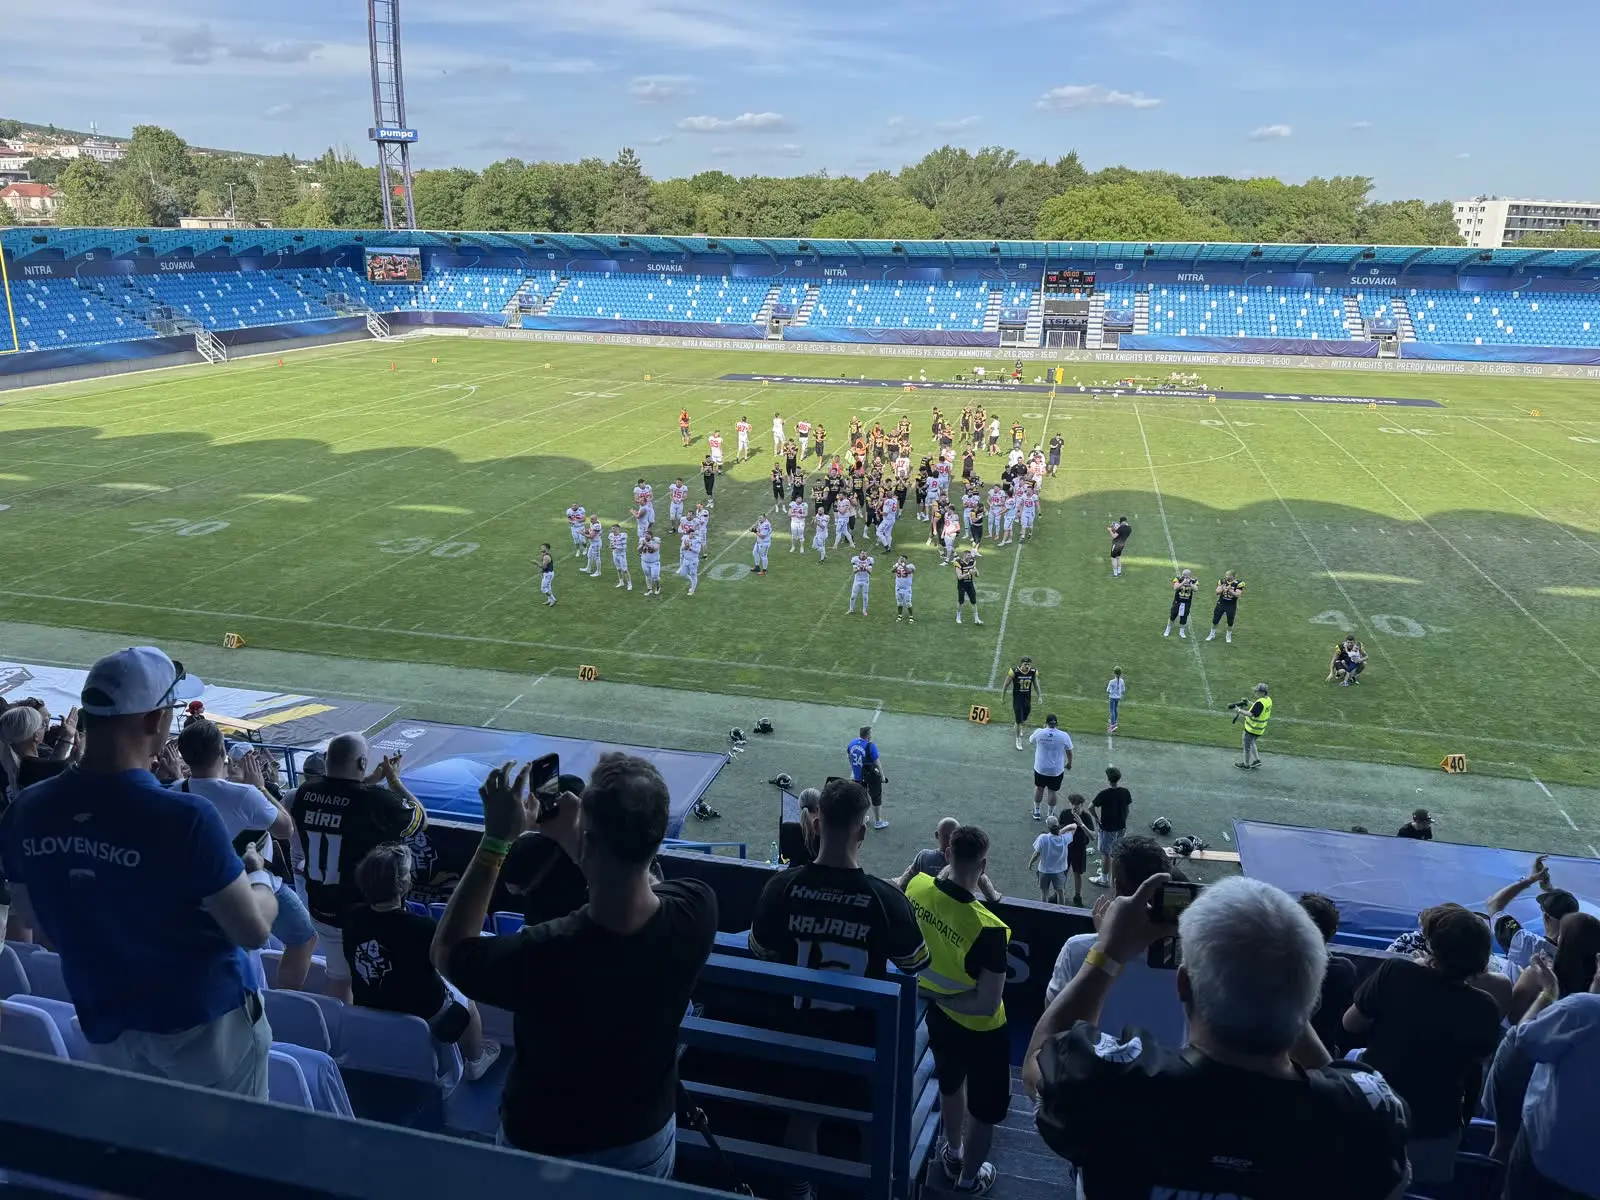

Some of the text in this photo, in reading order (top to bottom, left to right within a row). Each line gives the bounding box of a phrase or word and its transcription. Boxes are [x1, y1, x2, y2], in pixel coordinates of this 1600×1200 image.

[24, 265, 52, 275] NITRA
[160, 261, 195, 270] SLOVAKIA
[647, 264, 683, 272] SLOVAKIA
[824, 268, 848, 277] NITRA
[1177, 273, 1204, 282] NITRA
[1350, 277, 1397, 285] SLOVAKIA
[959, 350, 991, 358] MAMMOTHS
[1115, 354, 1142, 362] KNIGHTS
[1183, 355, 1219, 363] MAMMOTHS
[1351, 361, 1382, 369] KNIGHTS
[1426, 363, 1464, 372] MAMMOTHS
[1480, 365, 1515, 373] 21.6.2026
[1524, 366, 1542, 374] 15:00
[1179, 586, 1192, 597] 33
[225, 635, 236, 646] 30
[580, 668, 593, 680] 40
[972, 707, 985, 722] 50
[852, 753, 863, 768] 34
[1450, 756, 1464, 772] 40
[303, 791, 350, 807] BONARD
[22, 836, 141, 867] SLOVENSKO
[305, 830, 342, 885] 11
[790, 884, 872, 908] KNIGHTS
